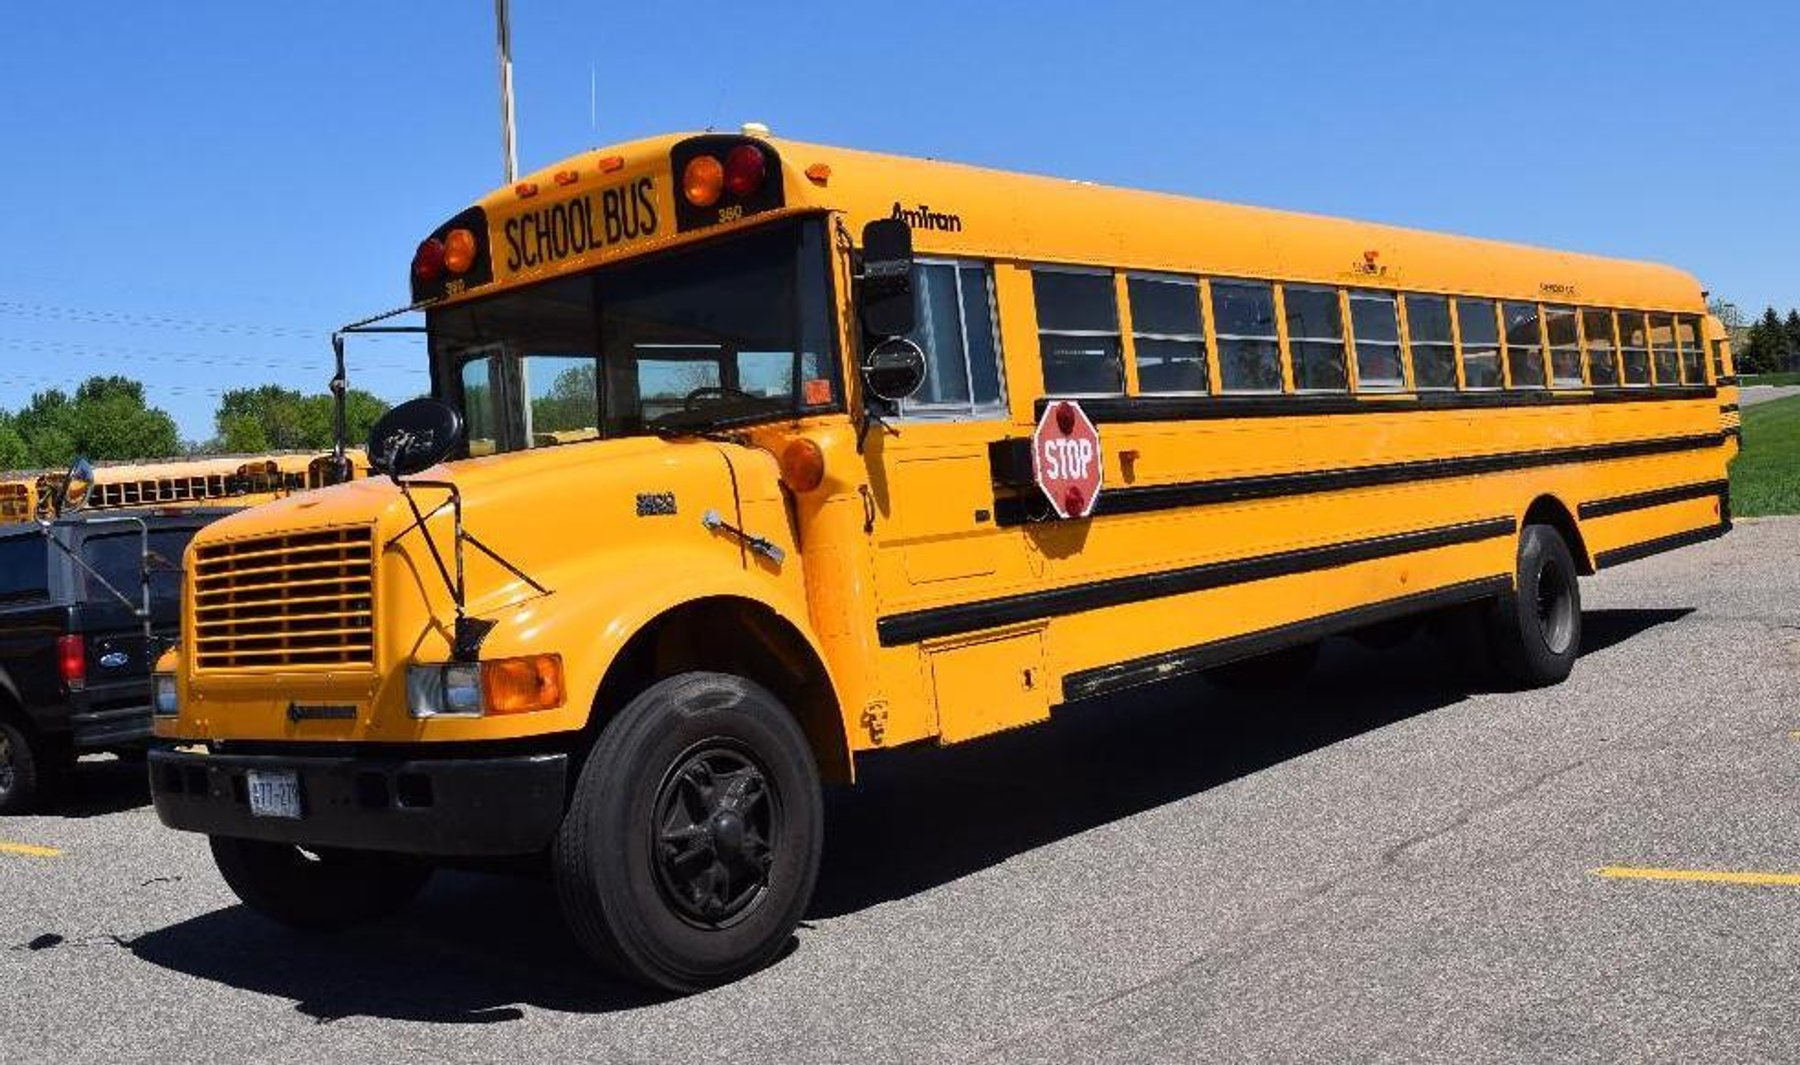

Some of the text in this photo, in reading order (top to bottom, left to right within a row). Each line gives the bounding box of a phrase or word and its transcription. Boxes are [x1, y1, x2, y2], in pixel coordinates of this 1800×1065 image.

[504, 177, 659, 270] SCHOOL BUS
[718, 205, 742, 223] 360
[890, 201, 961, 232] AmTran
[1044, 438, 1093, 480] STOP
